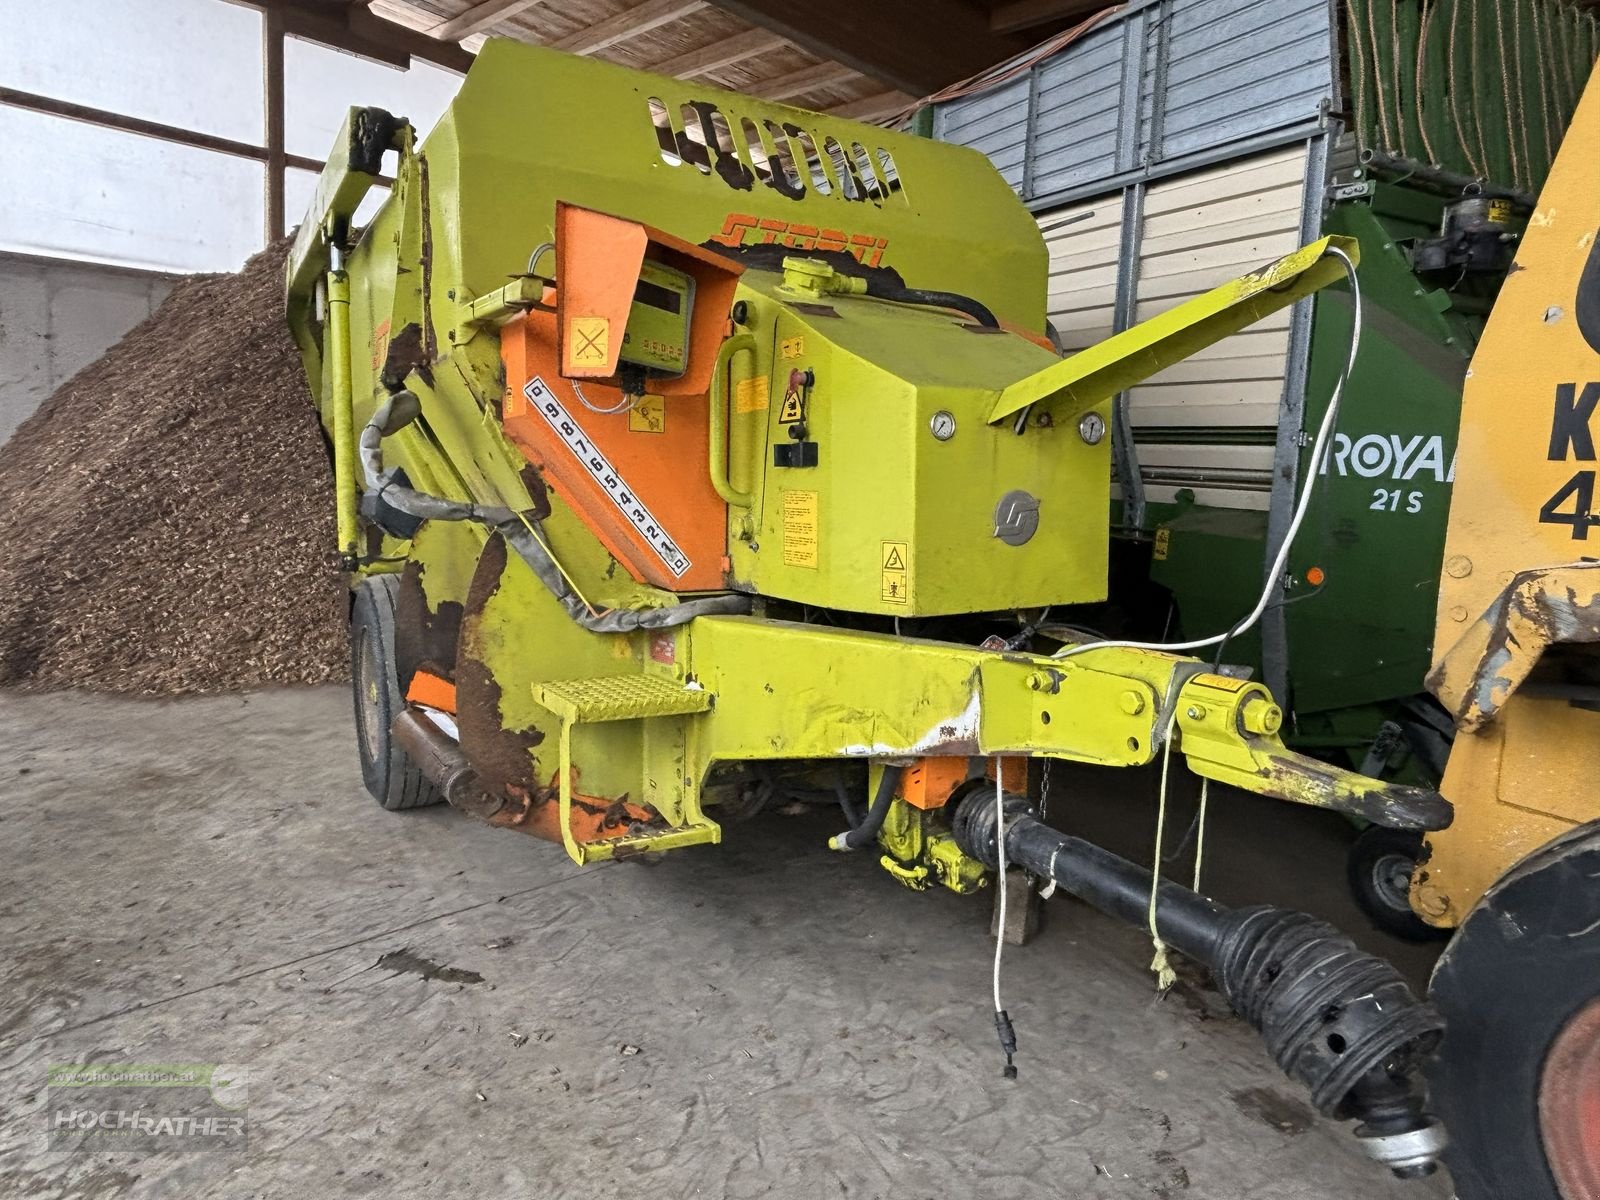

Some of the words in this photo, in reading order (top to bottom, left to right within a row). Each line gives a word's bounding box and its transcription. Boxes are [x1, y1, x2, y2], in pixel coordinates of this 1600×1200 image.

[1548, 381, 1600, 462] K
[545, 402, 560, 418] 9
[560, 421, 575, 436] 8
[575, 439, 588, 454] 7
[589, 457, 604, 472] 6
[604, 474, 618, 489] 5
[619, 491, 632, 506] 4
[632, 508, 646, 523] 3
[646, 524, 660, 540] 2
[1369, 488, 1401, 511] 21
[1406, 491, 1424, 513] S
